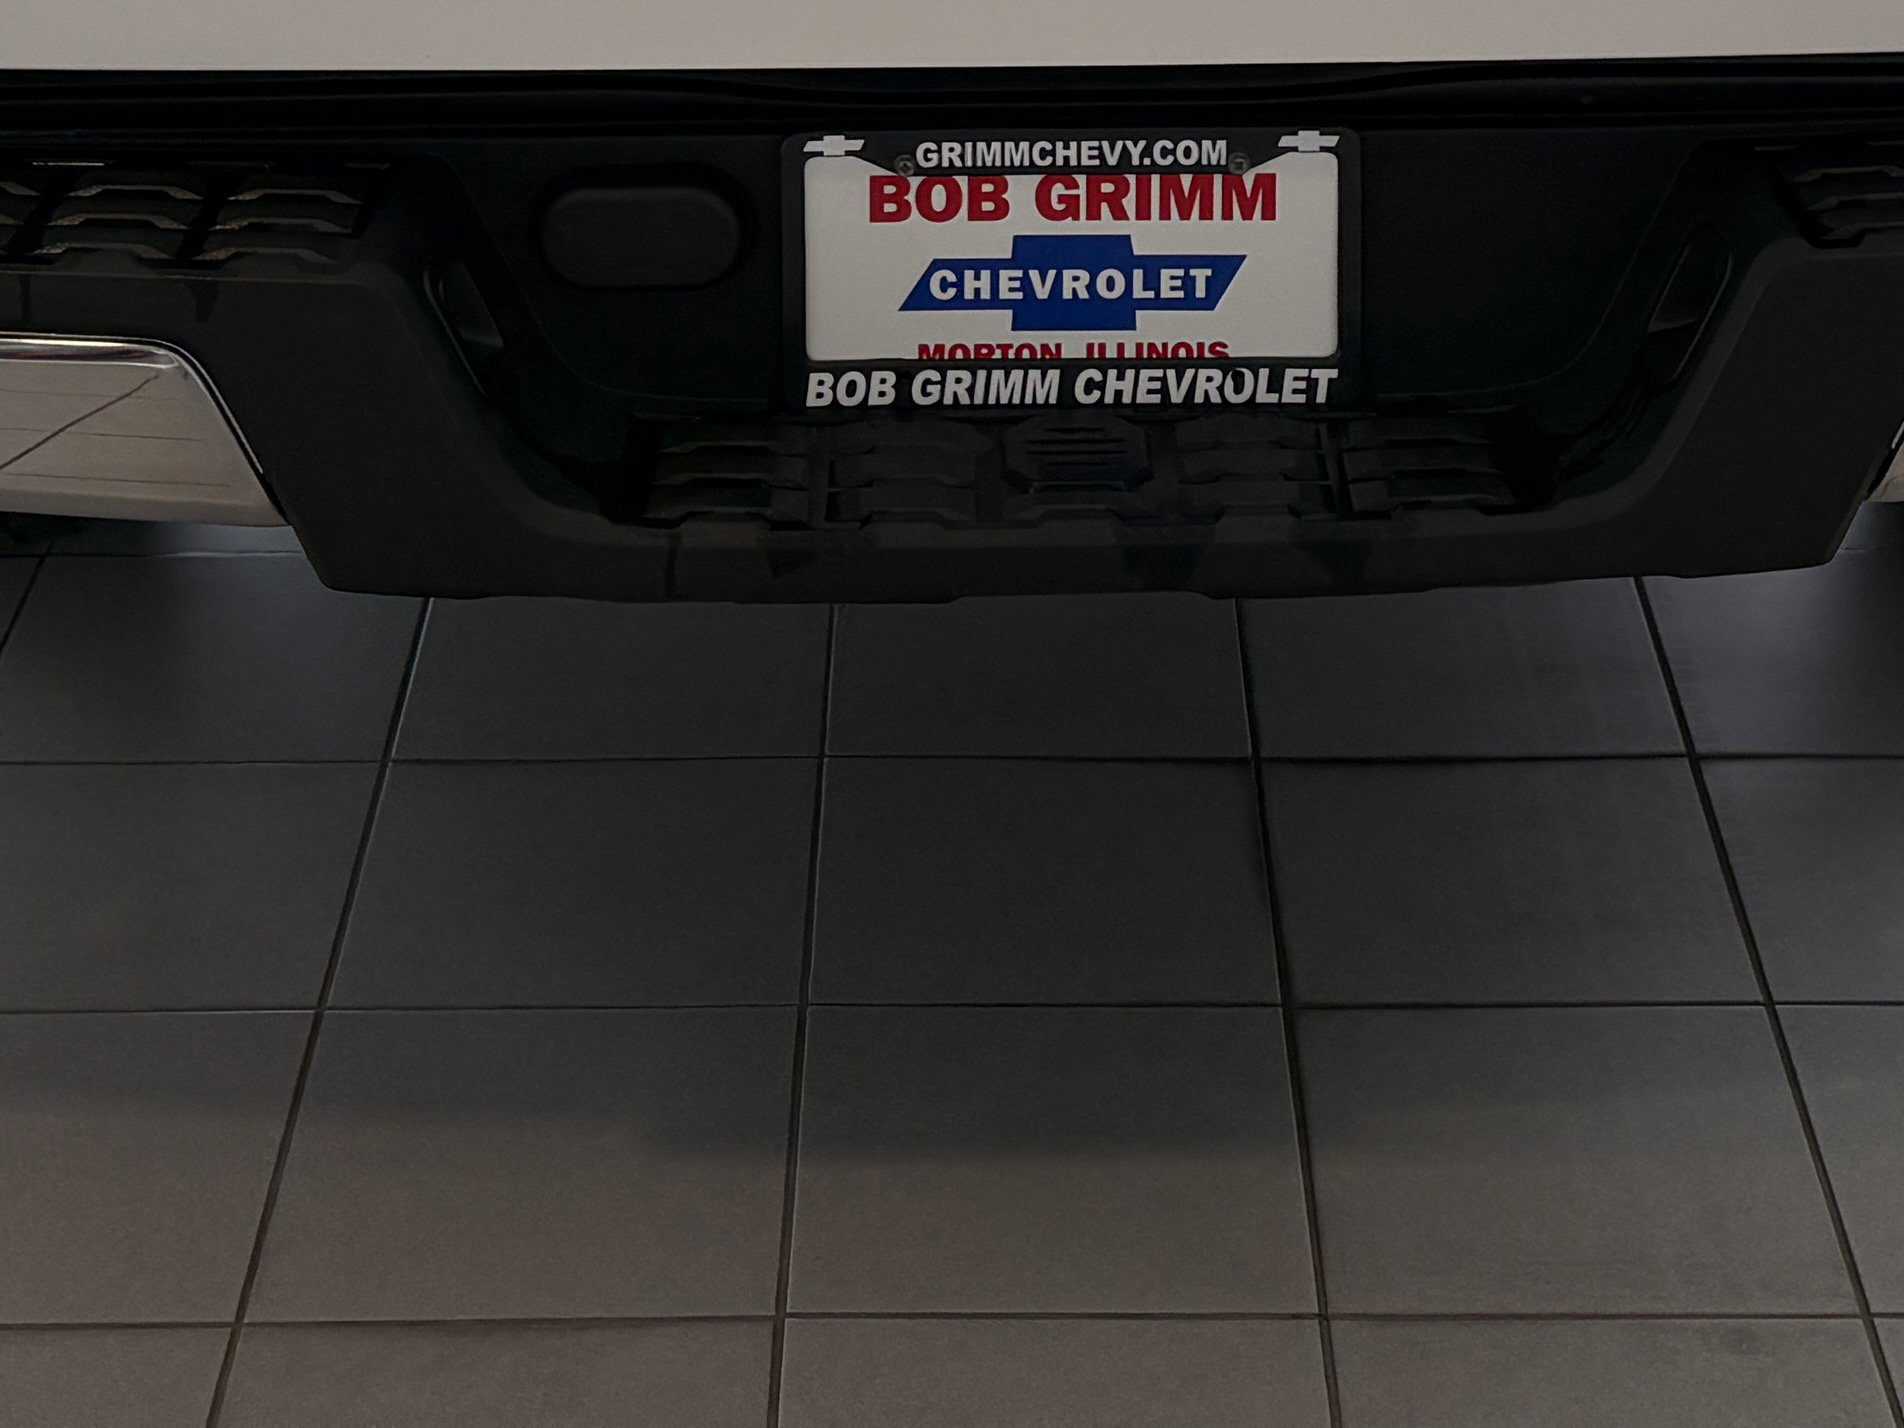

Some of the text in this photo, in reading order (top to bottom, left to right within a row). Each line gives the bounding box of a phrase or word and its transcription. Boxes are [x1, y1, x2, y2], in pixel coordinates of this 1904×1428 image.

[915, 140, 1227, 168] GRIMMCHEVY.COM
[869, 174, 1277, 222] BOB GRIMM
[929, 268, 1213, 301] CHEVROLET
[805, 368, 1339, 407] BOB GRIMM CHEVROLET
